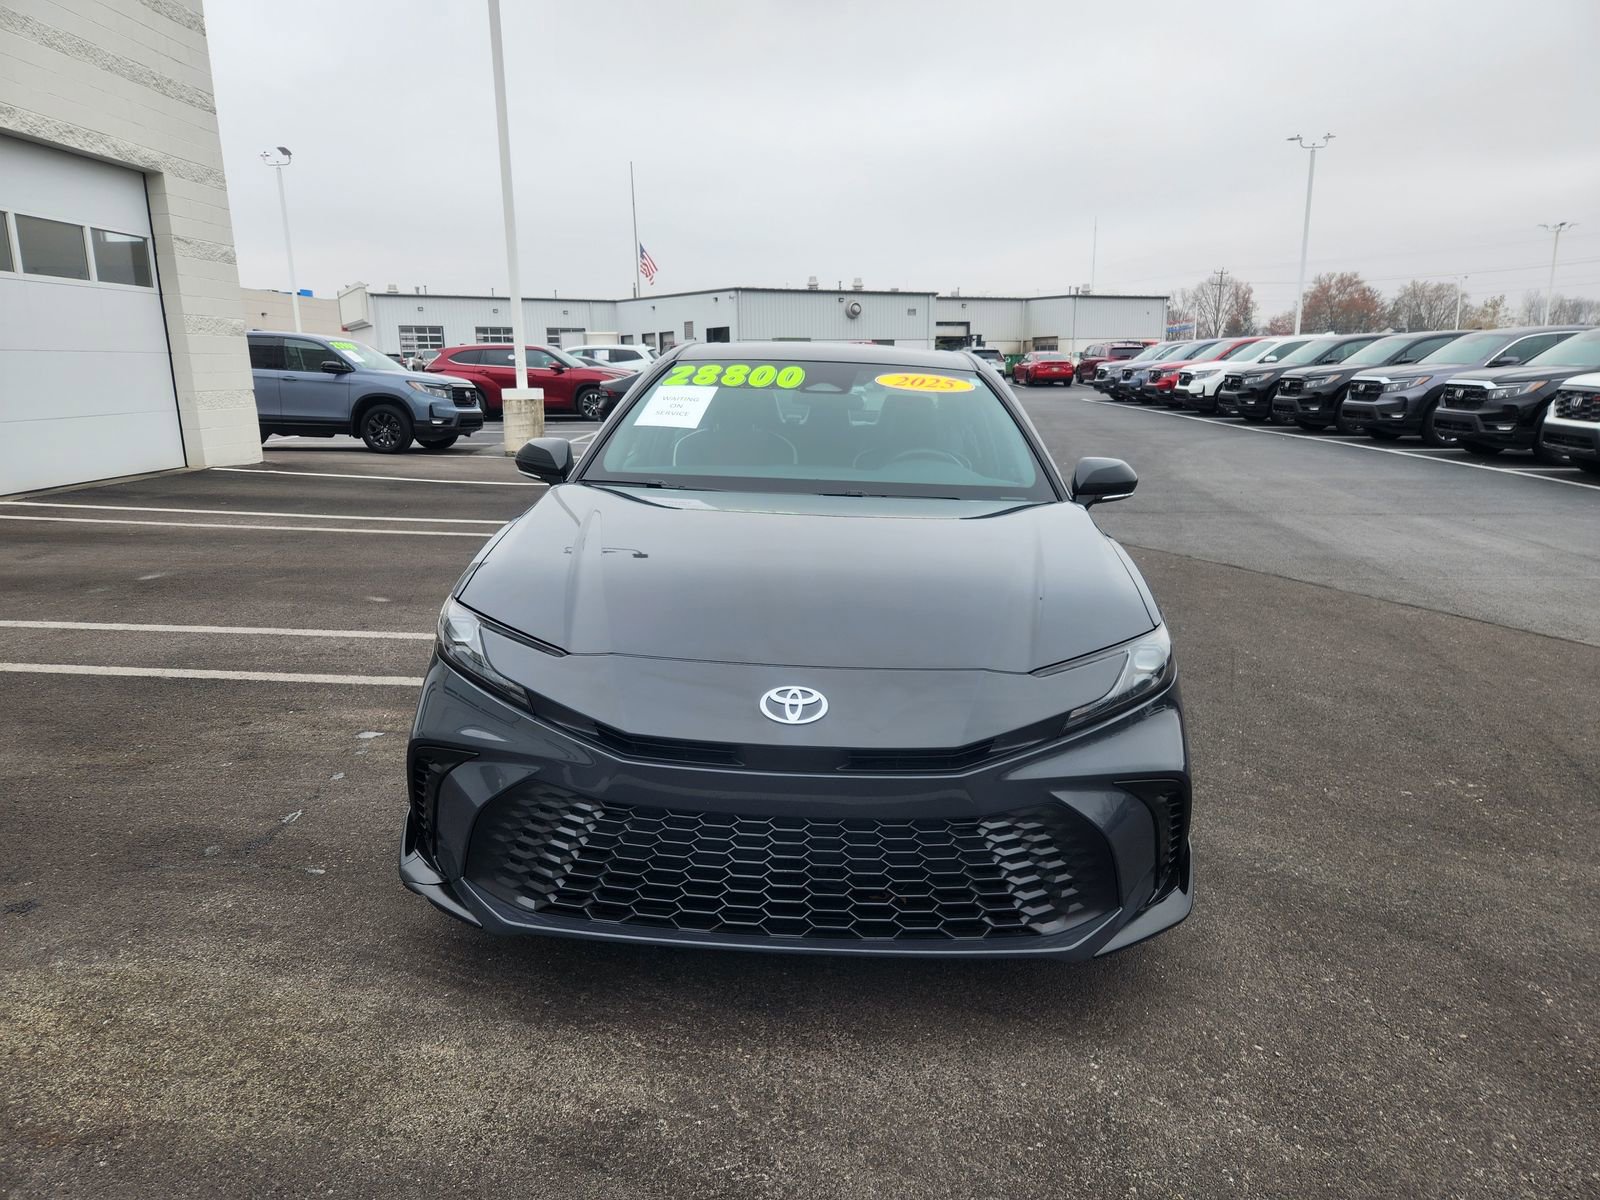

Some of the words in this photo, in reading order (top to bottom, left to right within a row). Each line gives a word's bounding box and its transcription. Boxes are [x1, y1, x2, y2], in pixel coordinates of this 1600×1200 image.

[662, 364, 806, 388] 28800
[894, 376, 957, 389] 2025
[662, 395, 700, 403] WAITING
